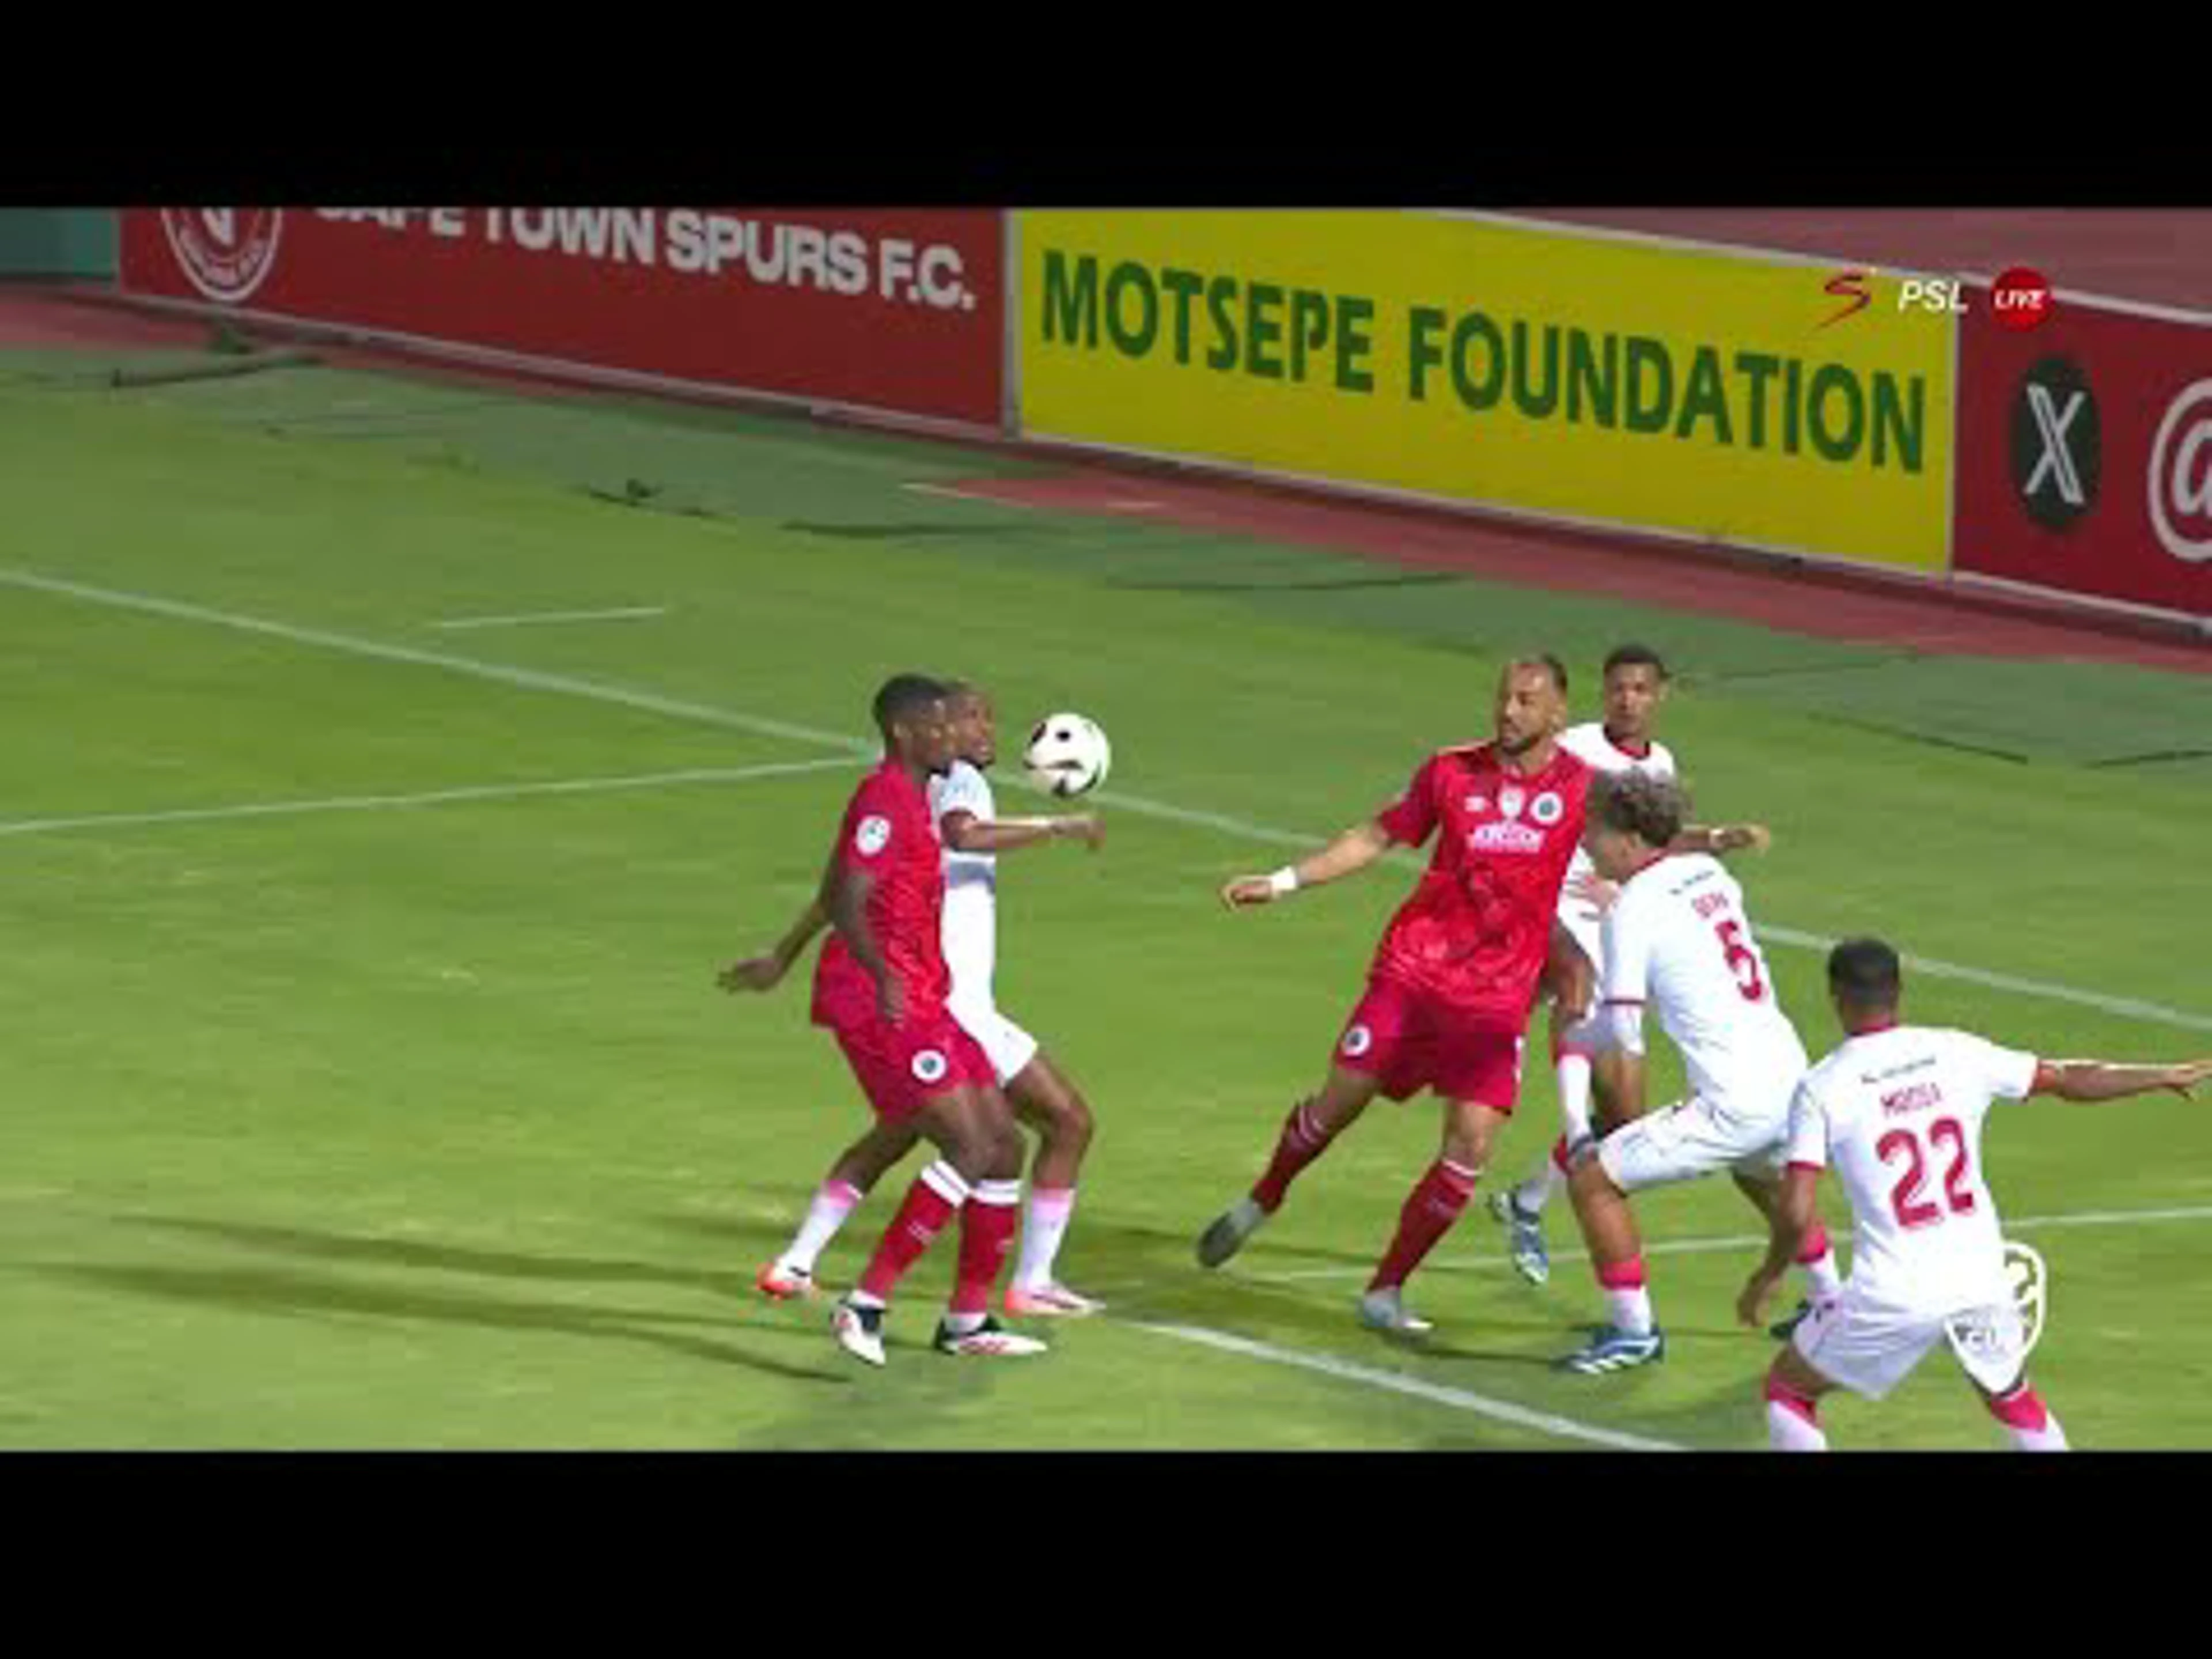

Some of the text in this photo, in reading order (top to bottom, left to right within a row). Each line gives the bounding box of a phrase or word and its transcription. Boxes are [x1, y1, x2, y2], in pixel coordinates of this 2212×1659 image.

[665, 208, 868, 295] SPURS
[879, 238, 978, 311] F.C.
[1041, 248, 1925, 474] MOTSEPE FOUNDATION
[1714, 920, 1763, 1002] 5
[1874, 1115, 1976, 1229] 22
